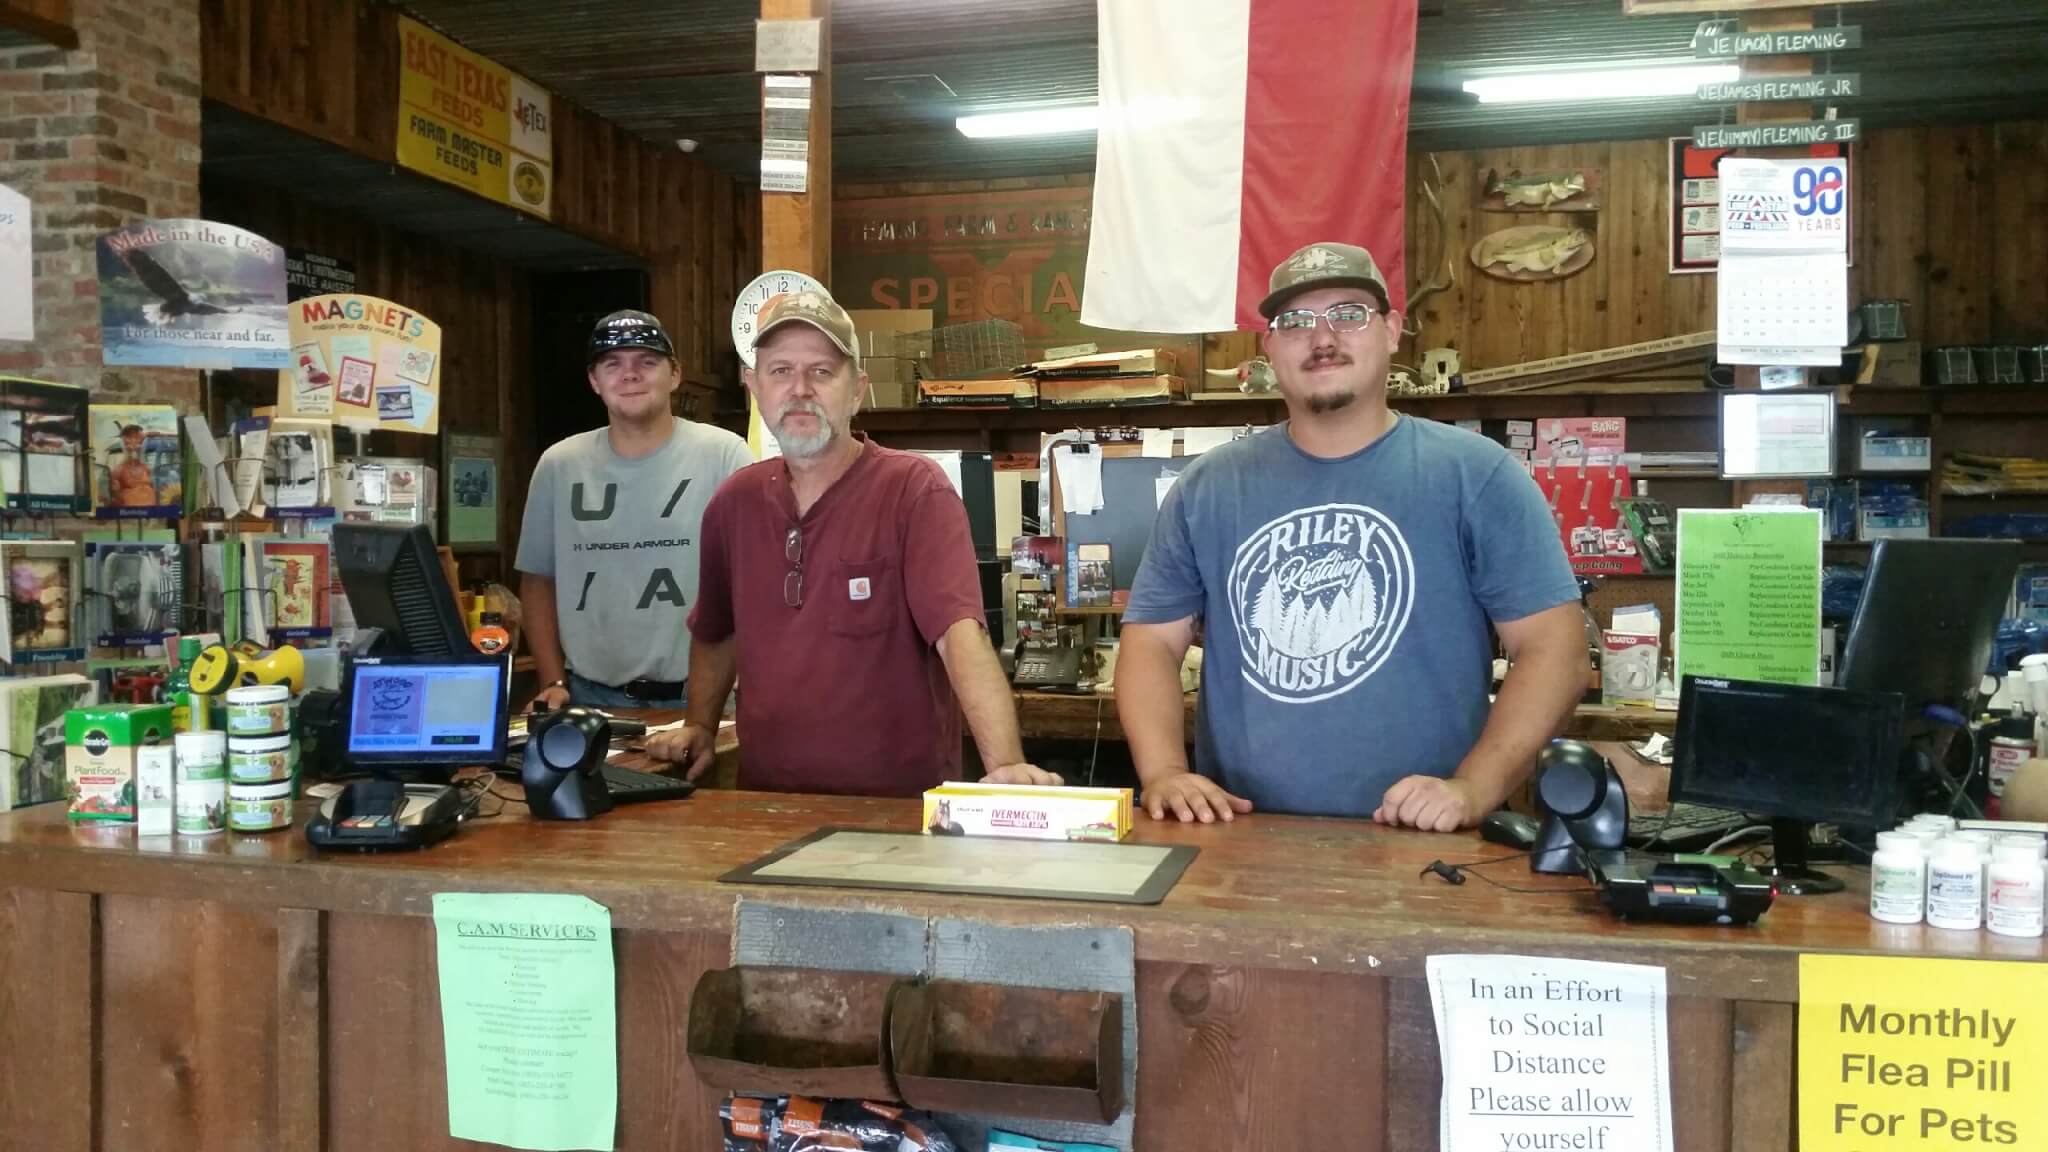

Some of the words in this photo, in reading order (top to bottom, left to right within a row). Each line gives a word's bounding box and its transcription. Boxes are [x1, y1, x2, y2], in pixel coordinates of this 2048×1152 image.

[1708, 36, 1729, 54] JE
[406, 31, 448, 86] EAST
[453, 56, 507, 112] TEXAS
[1764, 80, 1826, 98] FLEMING
[1832, 80, 1852, 95] JR
[432, 88, 484, 128] FEEDS
[410, 115, 448, 145] FARM
[452, 132, 503, 168] MASTER
[1763, 125, 1828, 144] FLEMING
[436, 147, 478, 176] FEEDS
[1798, 218, 1841, 231] YEARS
[107, 226, 166, 251] Made
[172, 226, 190, 241] in
[198, 228, 227, 245] the
[778, 280, 789, 292] 12
[871, 271, 1081, 315] SPECIA
[302, 300, 424, 337] MAGNETS
[743, 322, 751, 333] 9
[154, 324, 190, 340] those
[194, 327, 222, 342] near
[226, 327, 250, 342] and
[254, 329, 275, 343] far.
[1592, 421, 1619, 432] BANG
[571, 483, 617, 521] U
[586, 542, 629, 551] UNDER
[633, 539, 690, 549] ARMOUR
[1259, 512, 1379, 573] RILEY
[1278, 549, 1363, 595] Redding
[635, 568, 686, 609] A
[1256, 628, 1366, 691] MUSIC
[991, 808, 1048, 821] IVERMECTIN
[508, 923, 596, 938] SERVICES
[1470, 978, 1494, 999] In
[1504, 985, 1533, 1000] an
[1545, 980, 1623, 1002] Effort
[1489, 1016, 1513, 1035] to
[1523, 1013, 1604, 1036] Social
[1839, 1003, 2016, 1047] Monthly
[1492, 1050, 1606, 1074] Distance
[1841, 1053, 1929, 1087] Flea
[1947, 1058, 2011, 1092] Pill
[1469, 1087, 1551, 1111] Please
[1561, 1088, 1633, 1112] allow
[1834, 1103, 1905, 1137] For
[1920, 1108, 2017, 1144] Pets
[1500, 1126, 1610, 1152] yourself
